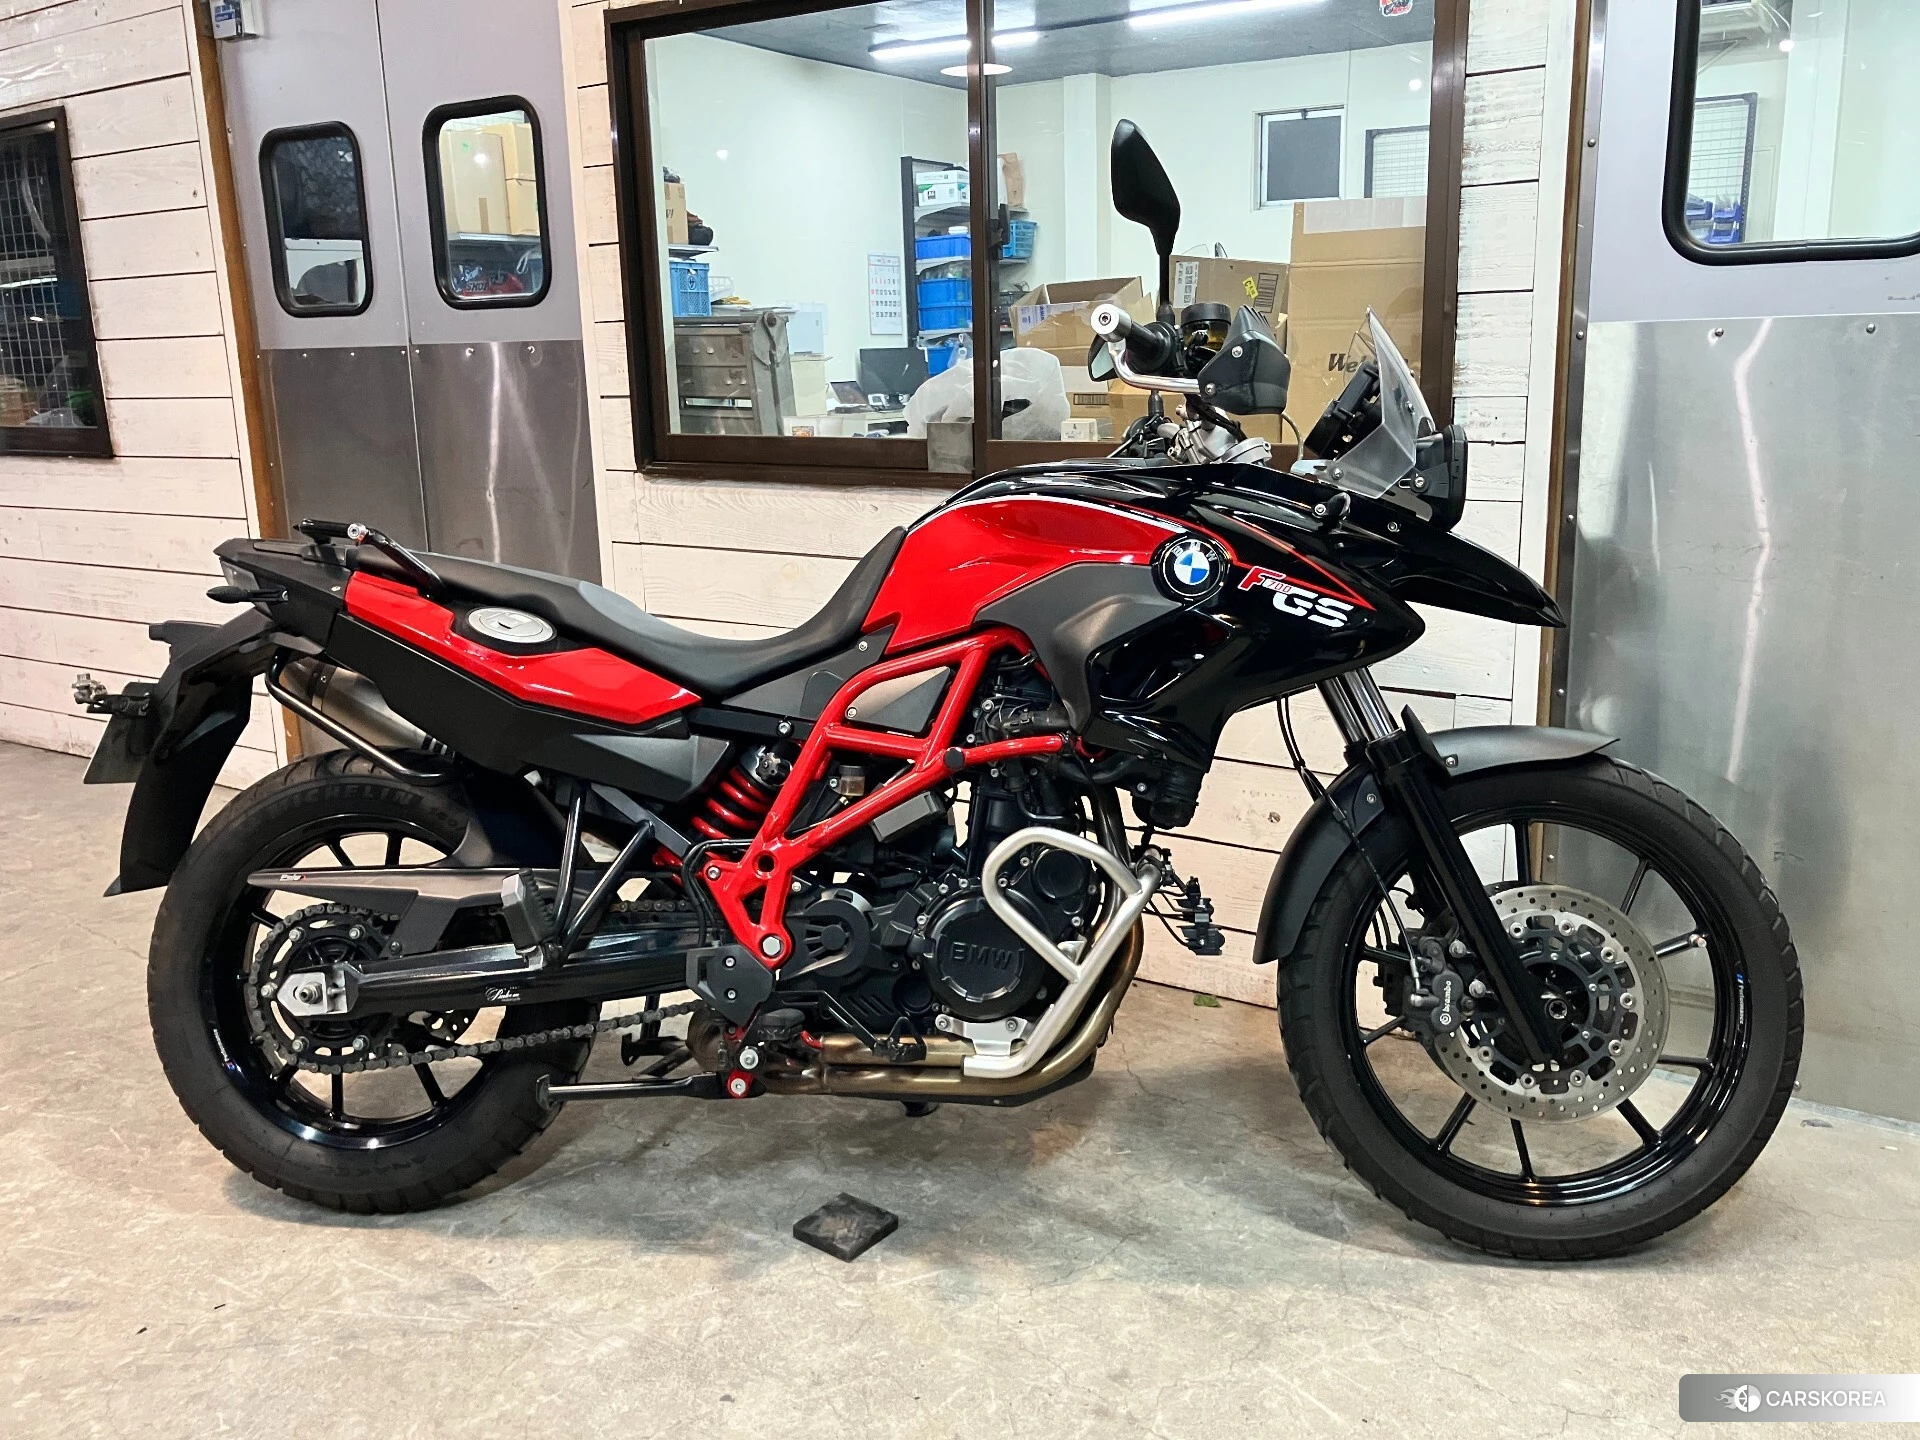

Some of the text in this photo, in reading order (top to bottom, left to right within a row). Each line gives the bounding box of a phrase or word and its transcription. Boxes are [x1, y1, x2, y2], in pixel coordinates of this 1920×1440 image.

[1171, 541, 1218, 561] BMW
[1262, 579, 1354, 628] GS
[266, 783, 424, 818] MICHELIN
[950, 941, 1013, 970] BMW
[1442, 980, 1451, 1012] brembo
